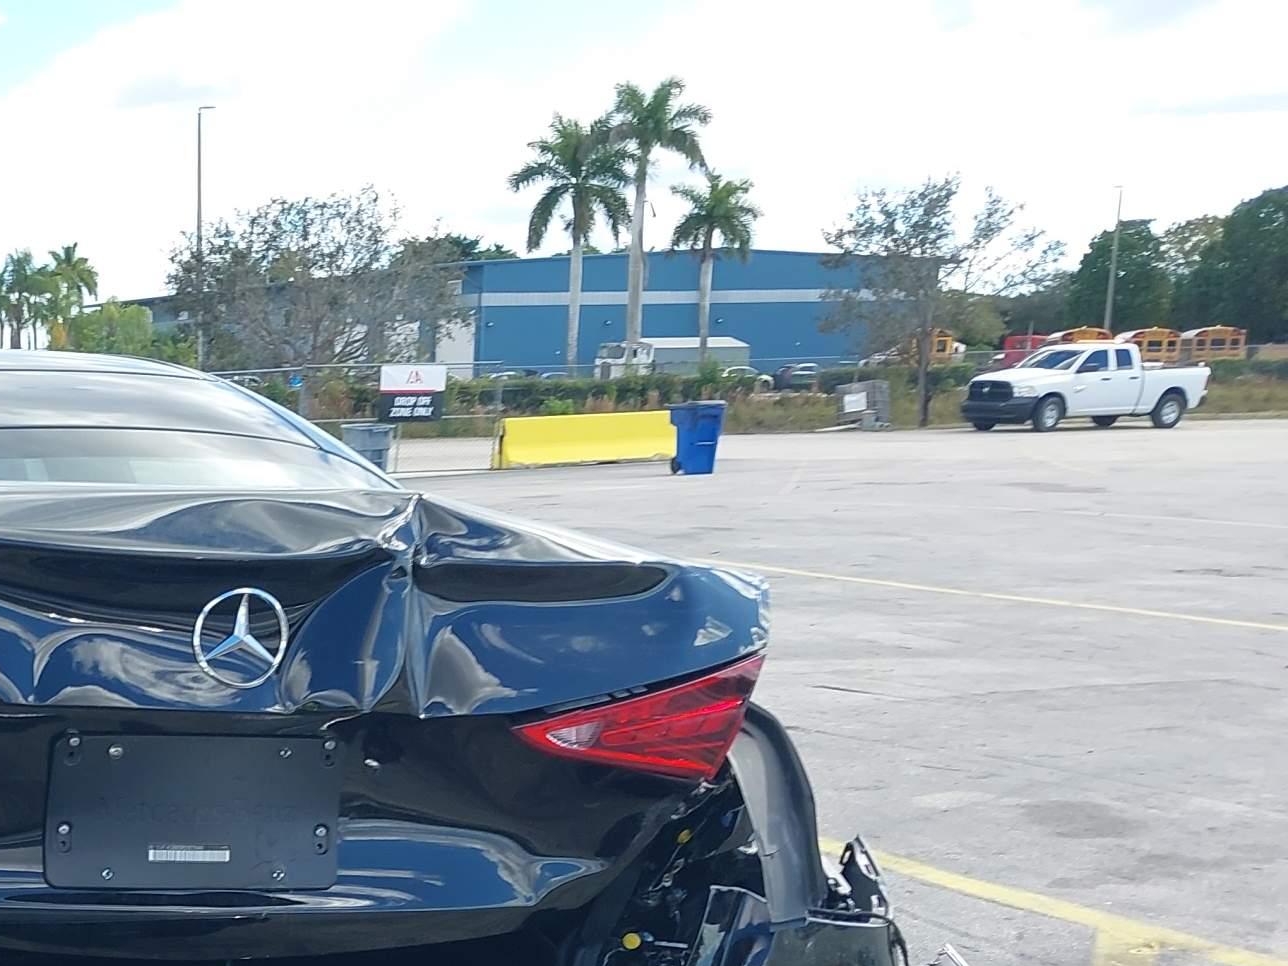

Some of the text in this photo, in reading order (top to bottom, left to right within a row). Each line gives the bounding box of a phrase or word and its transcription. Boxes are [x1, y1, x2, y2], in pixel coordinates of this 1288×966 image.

[393, 396, 432, 406] DROP OFF
[389, 406, 434, 417] ZONE ONLY
